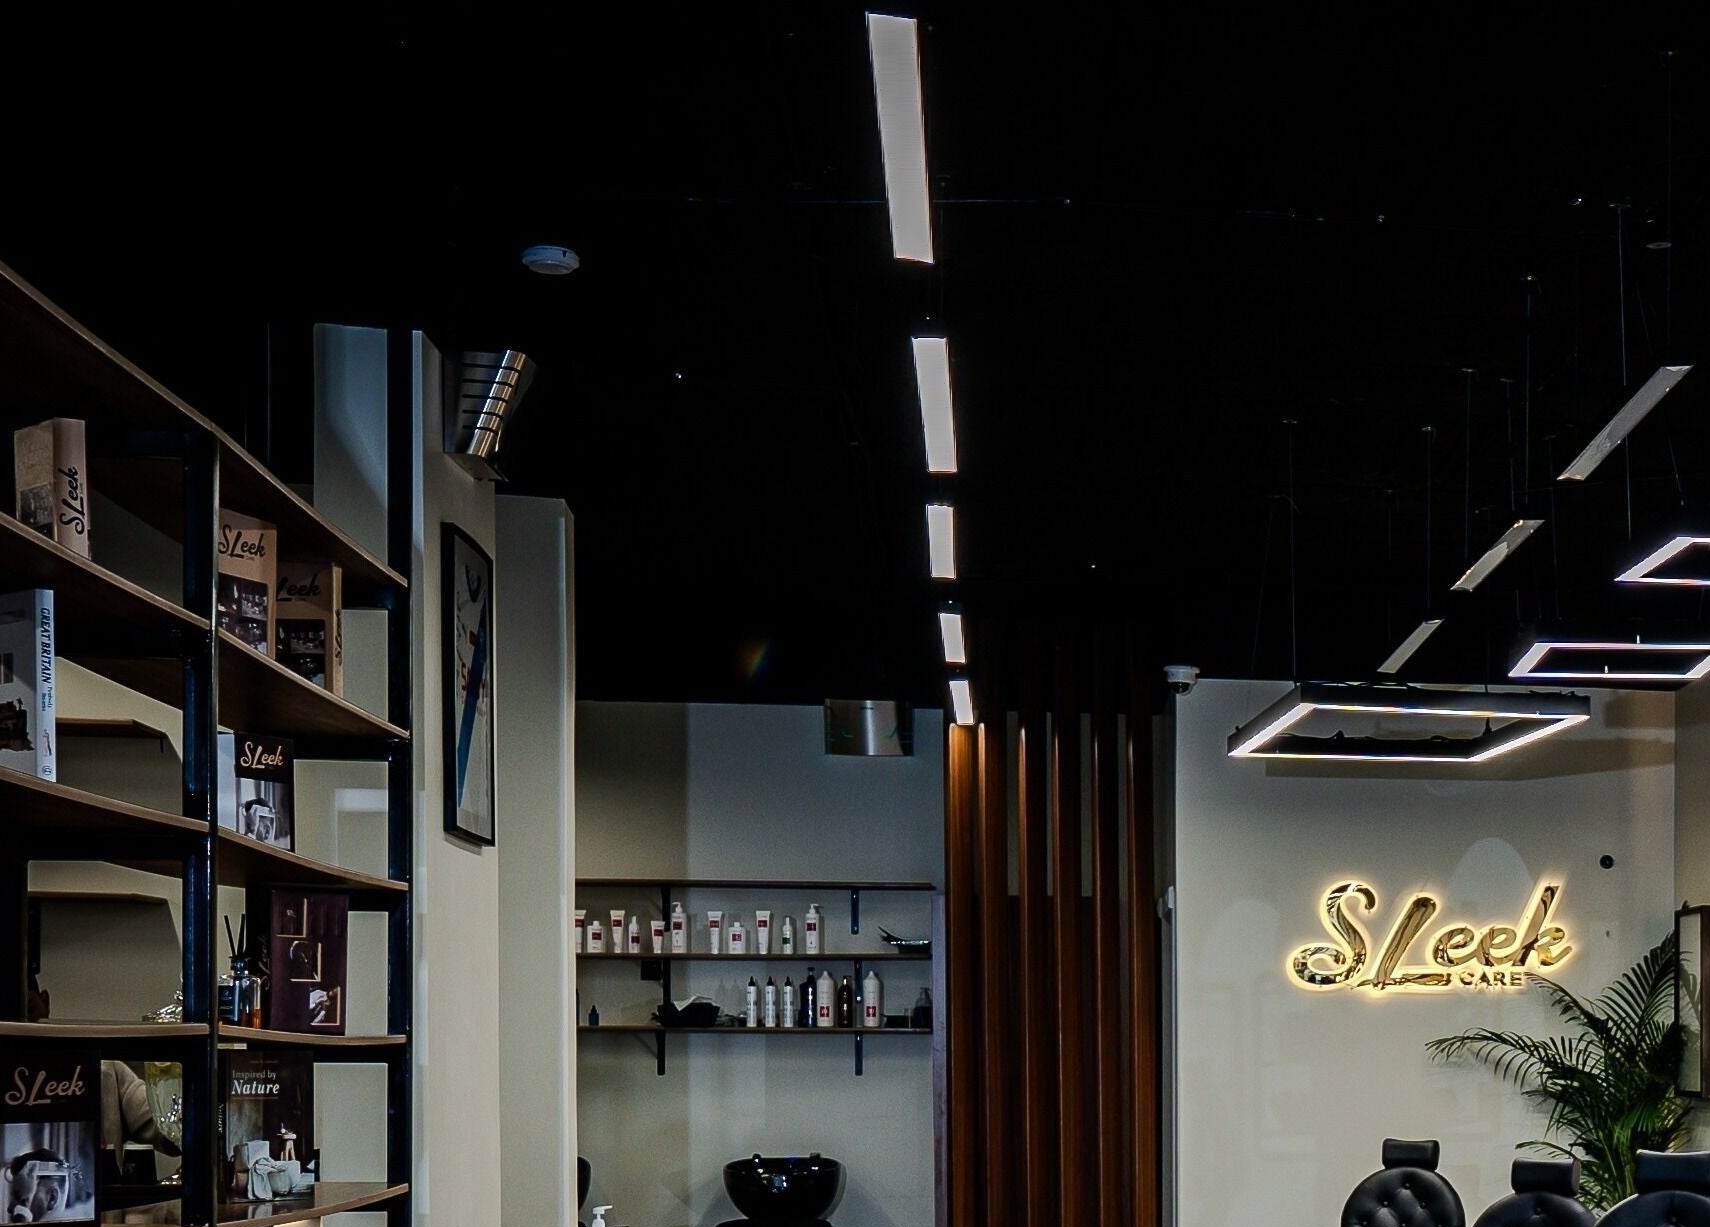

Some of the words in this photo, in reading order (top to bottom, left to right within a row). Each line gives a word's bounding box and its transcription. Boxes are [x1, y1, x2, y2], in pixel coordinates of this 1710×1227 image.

[40, 607, 51, 642] GREAT
[41, 643, 52, 684] BRITAIN
[1459, 971, 1524, 987] CARE
[232, 1069, 266, 1081] Inspired
[267, 1069, 277, 1081] by
[231, 1080, 280, 1095] Nature
